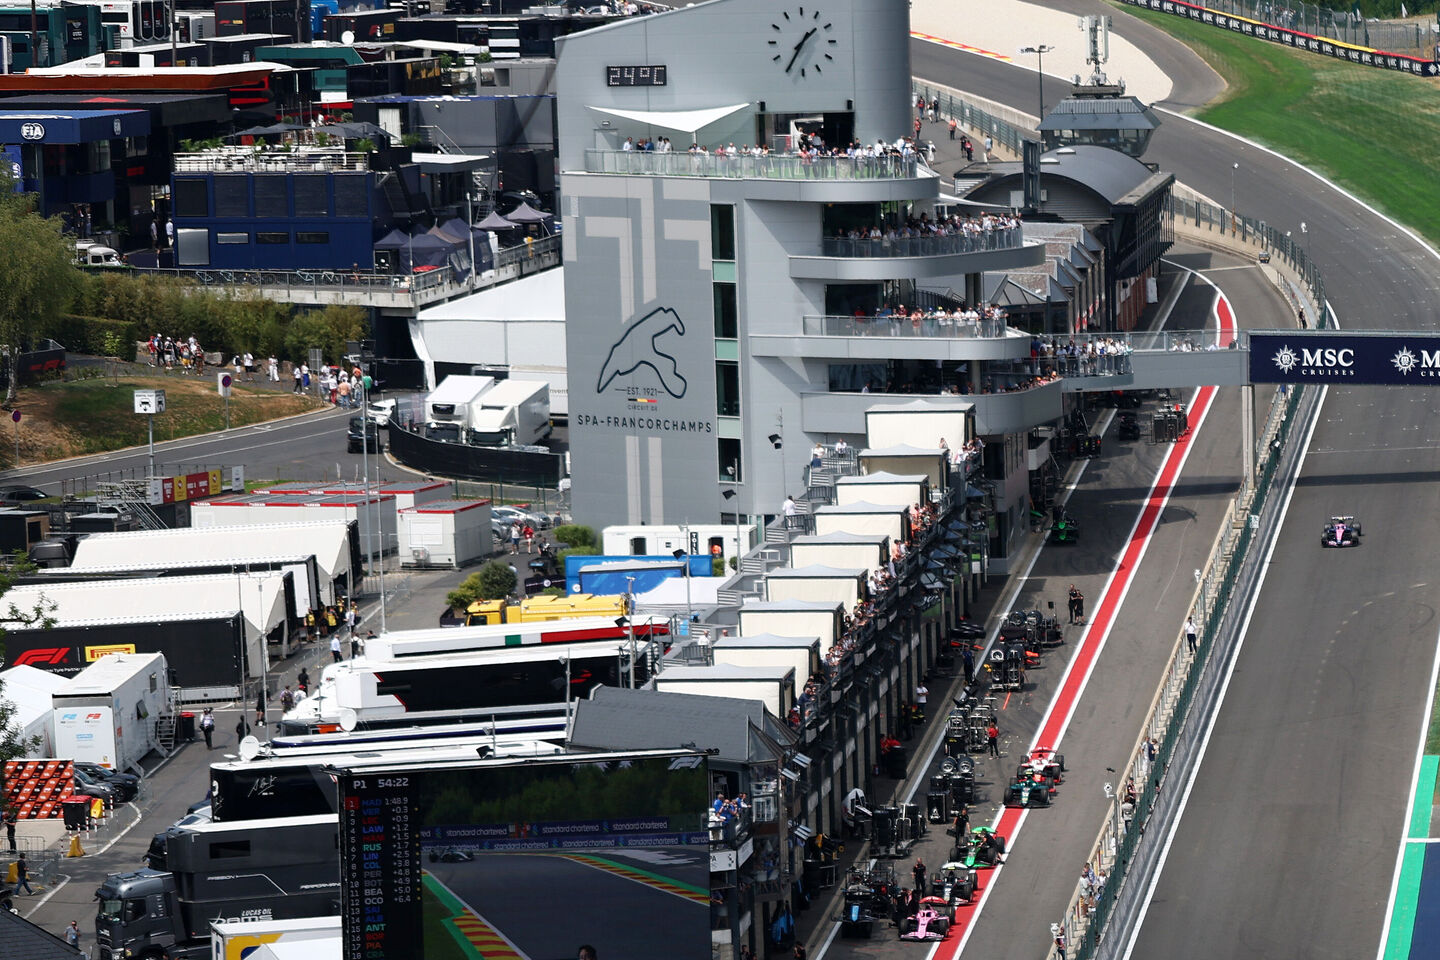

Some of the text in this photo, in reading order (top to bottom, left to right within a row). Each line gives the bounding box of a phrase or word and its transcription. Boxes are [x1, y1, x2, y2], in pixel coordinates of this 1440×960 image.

[23, 124, 43, 138] FIA
[1302, 348, 1354, 367] MSC
[627, 387, 658, 396] EST. 1921
[577, 414, 712, 433] SPA-FRANCORCHAMPS
[12, 647, 71, 666] F1
[353, 778, 409, 789] P1 54:22
[362, 825, 384, 833] LAW
[363, 843, 382, 851] RUS
[366, 924, 386, 932] ANT
